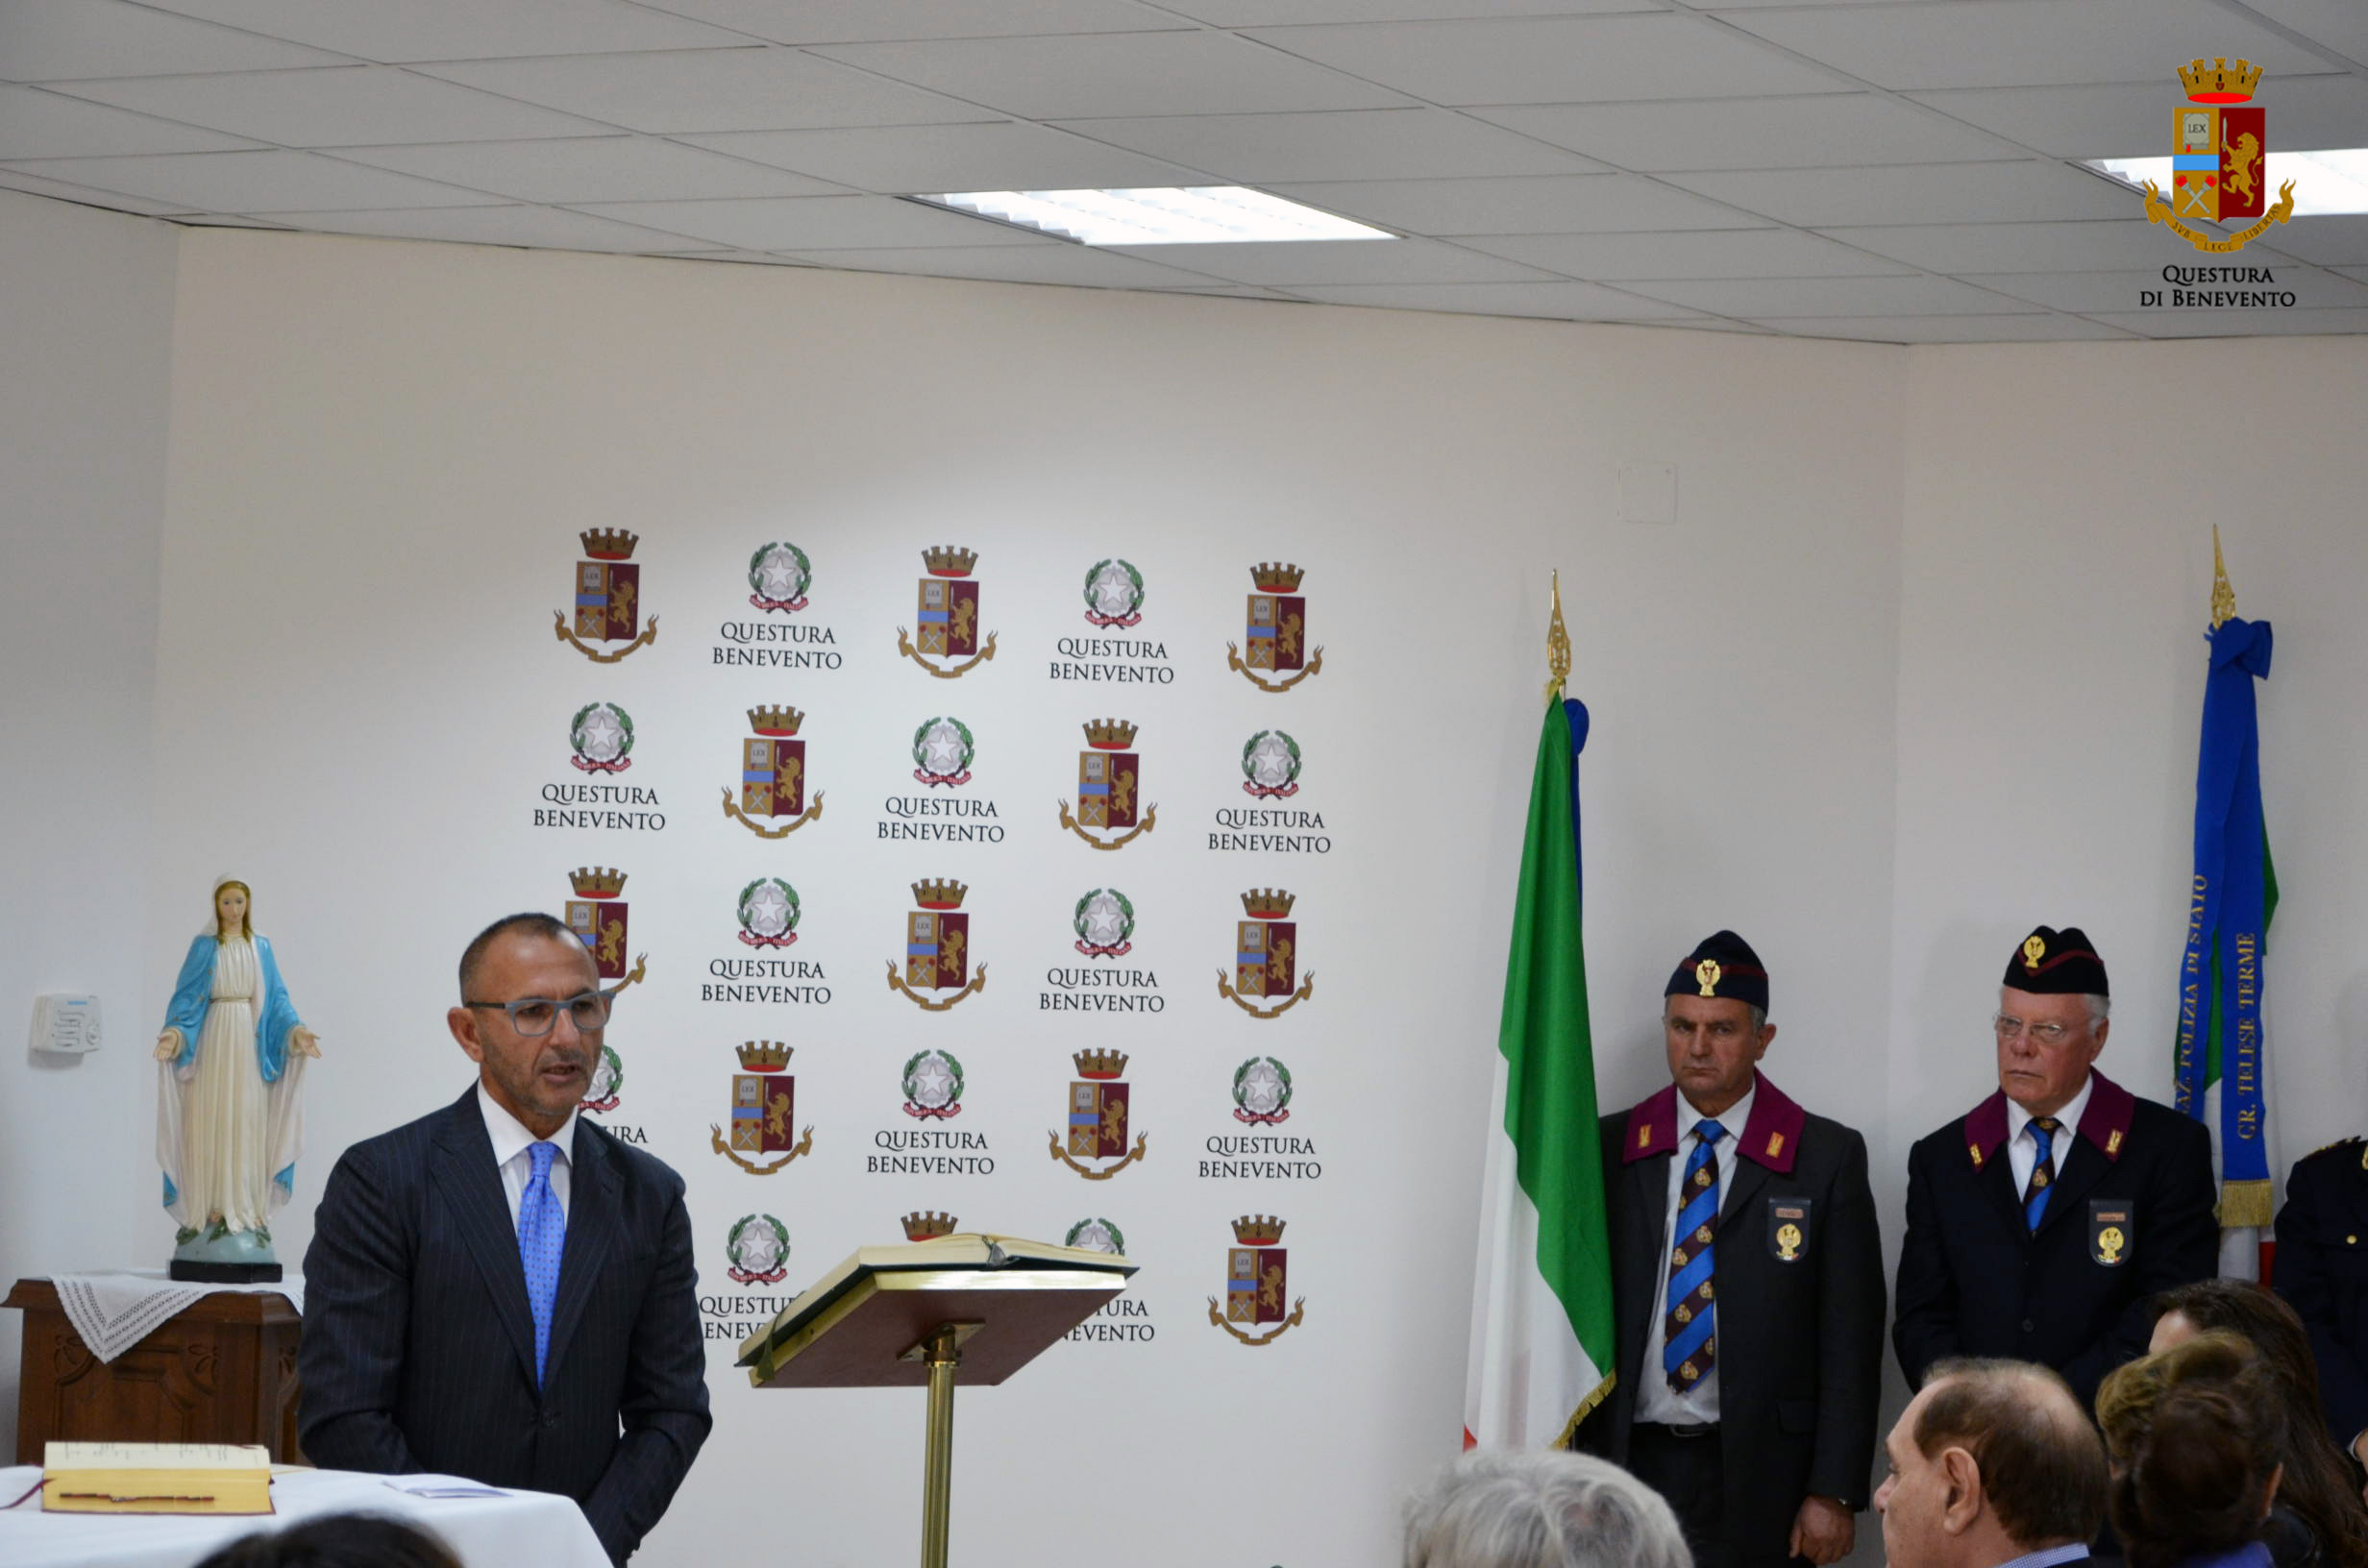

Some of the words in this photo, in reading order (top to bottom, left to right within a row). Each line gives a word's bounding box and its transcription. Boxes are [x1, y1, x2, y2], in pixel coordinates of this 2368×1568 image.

[721, 623, 835, 644] QUESTURA
[713, 648, 842, 670] BENEVENTO
[1057, 638, 1168, 659] QUESTURA
[1049, 663, 1173, 684] BENEVENTO
[541, 784, 659, 805] QUESTURA
[886, 796, 999, 818] QUESTURA
[533, 810, 665, 830] BENEVENTO
[1216, 809, 1324, 830] QUESTURA
[877, 822, 1004, 843] BENEVENTO
[1208, 834, 1330, 853] BENEVENTO
[2189, 874, 2208, 944] STATO
[709, 960, 825, 980] QUESTURA
[1047, 968, 1157, 989] QUESTURA
[2237, 933, 2256, 1008] TERME
[702, 985, 831, 1004] BENEVENTO
[1040, 993, 1164, 1013] BENEVENTO
[2238, 1017, 2256, 1094] TELESE
[2237, 1103, 2257, 1139] GR.
[876, 1131, 988, 1152] QUESTURA
[1206, 1137, 1315, 1157] QUESTURA
[867, 1156, 994, 1175] BENEVENTO
[1199, 1162, 1321, 1180] BENEVENTO
[700, 1296, 796, 1317] QUESTU
